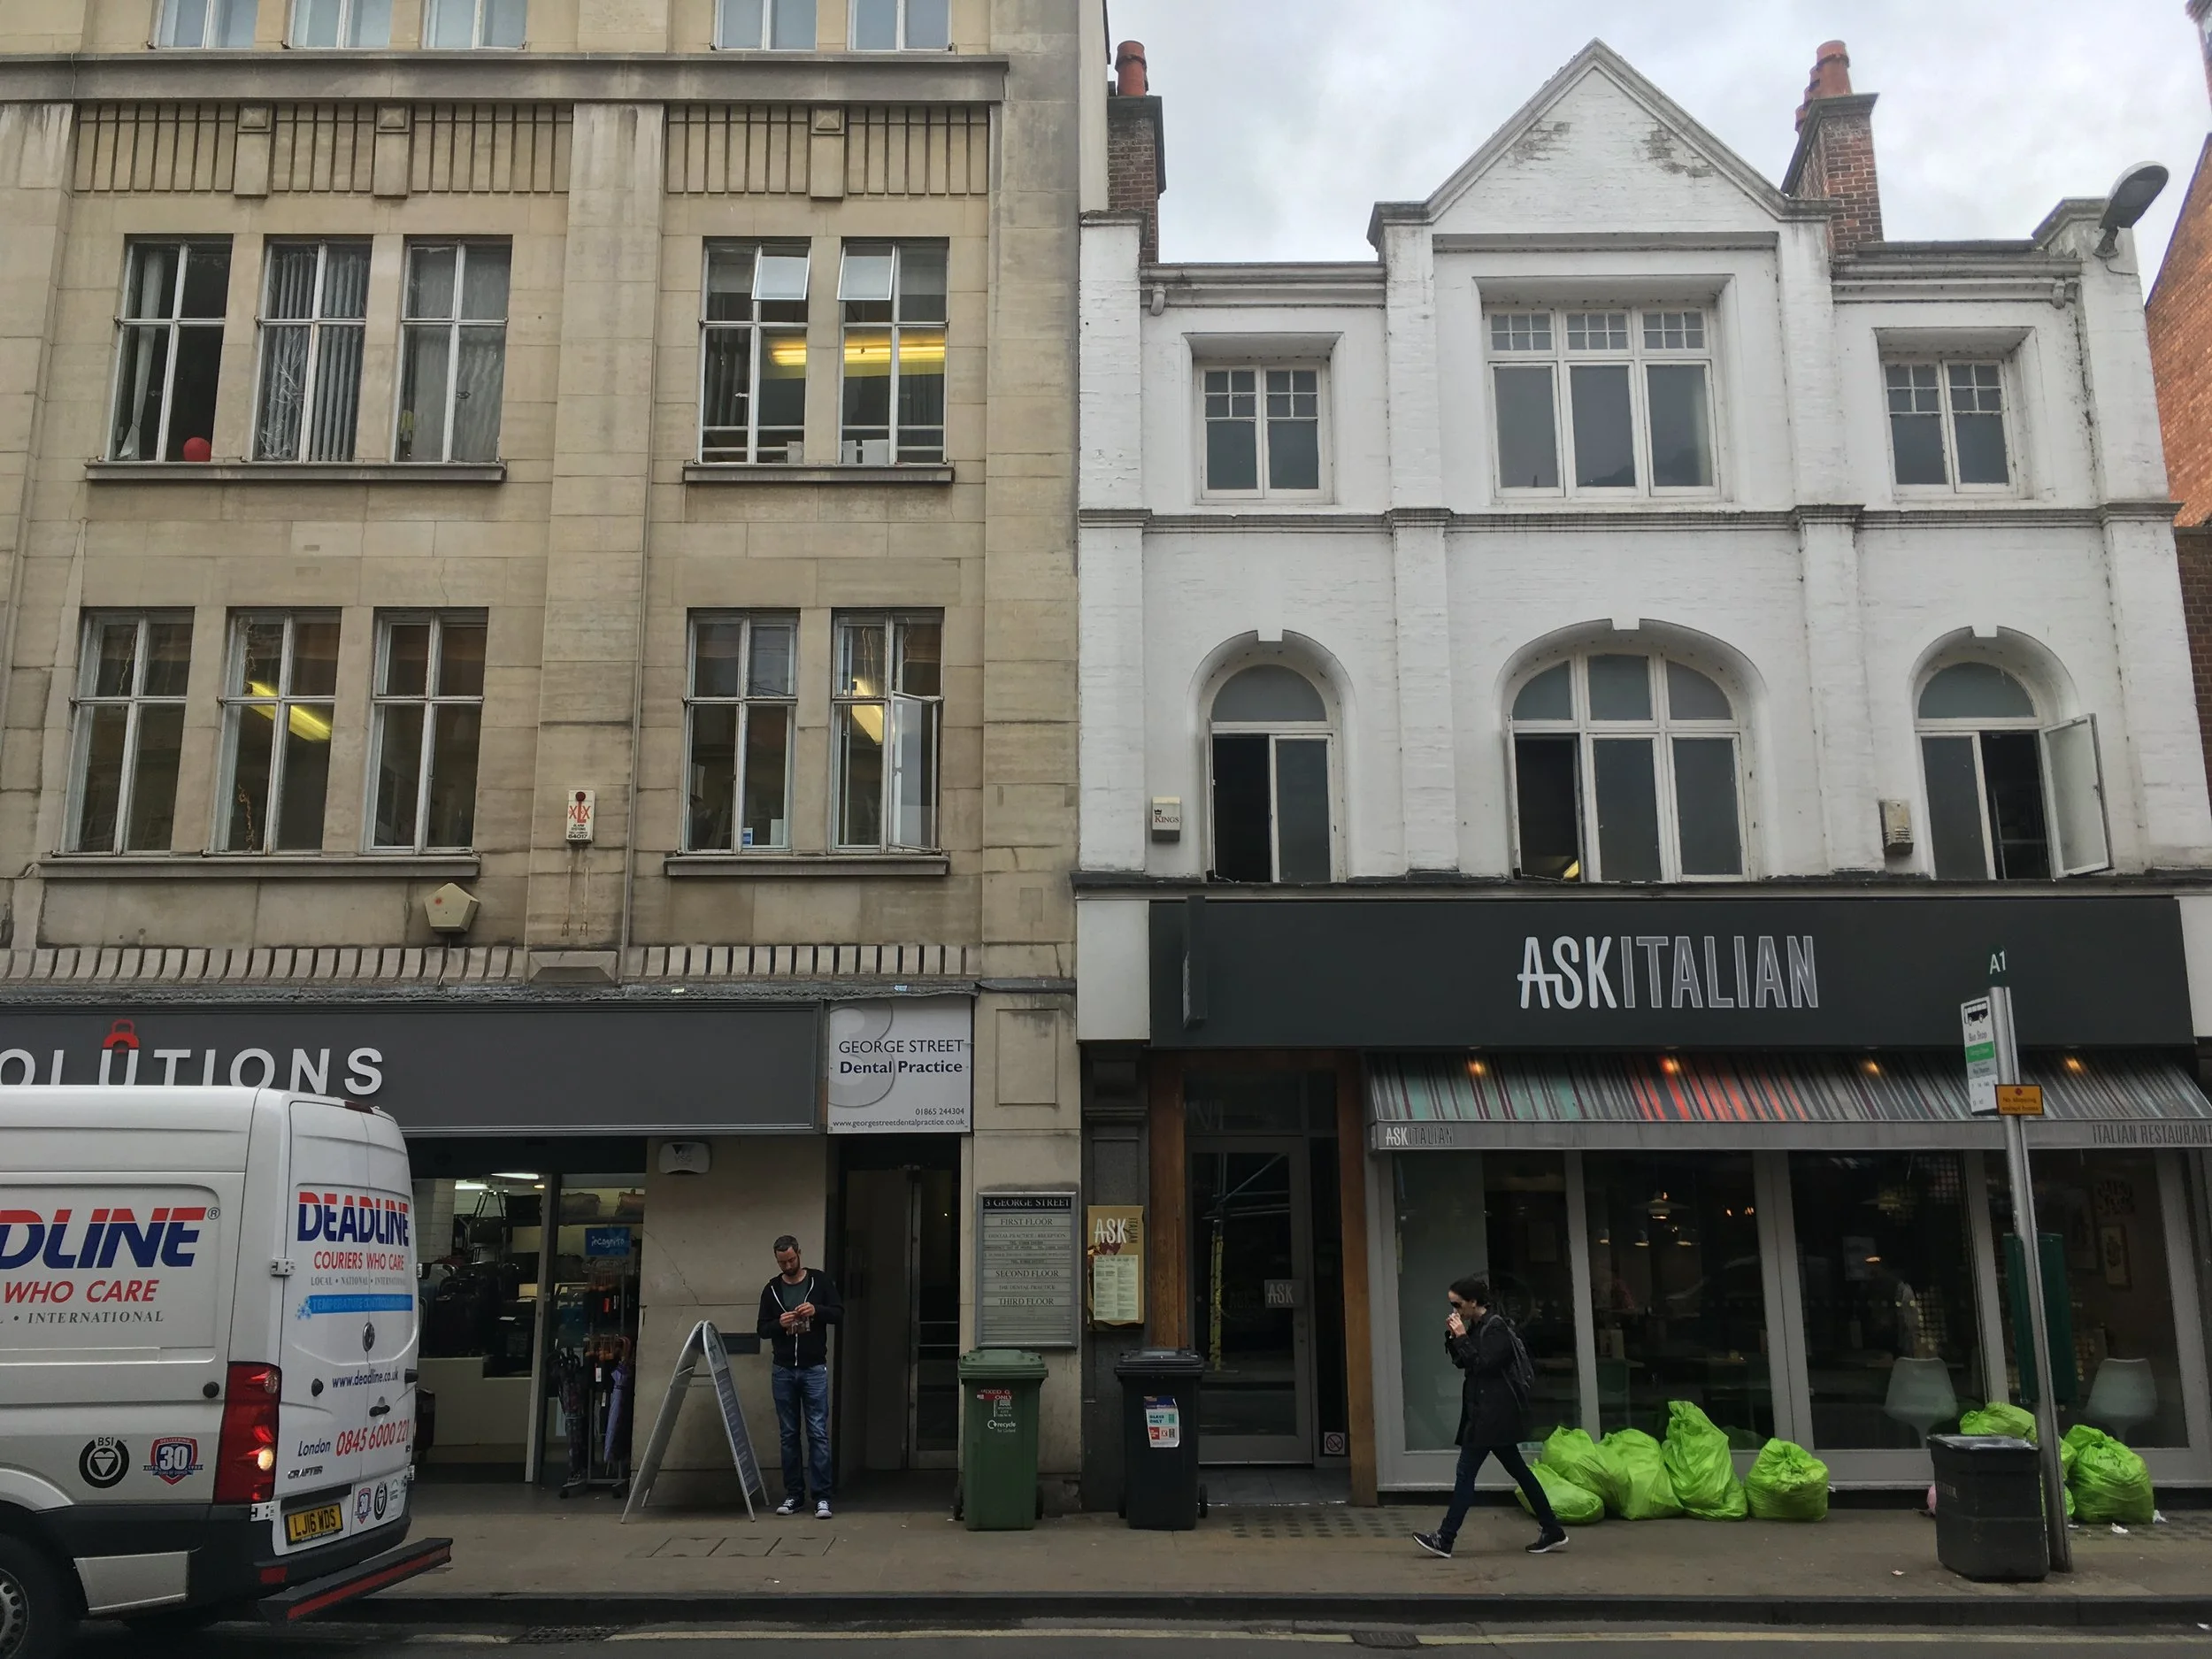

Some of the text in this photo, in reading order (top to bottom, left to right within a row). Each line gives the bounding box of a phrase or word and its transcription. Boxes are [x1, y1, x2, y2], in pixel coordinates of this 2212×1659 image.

[1989, 950, 2007, 974] A1
[1517, 935, 1819, 1010] ASK ITALIAN
[839, 1040, 964, 1053] GEORGE STREET
[840, 1060, 963, 1074] Dental Practice
[833, 1118, 964, 1128] www.georgestreetdentalpractice.co.uk
[1386, 1126, 1454, 1146] ASK ITALIAN
[2093, 1125, 2138, 1144] ITALIAN
[297, 1191, 410, 1247] DEADLINE
[1094, 1217, 1126, 1244] ASK
[313, 1251, 403, 1271] COURIERS WHO CARE
[311, 1277, 333, 1286] LOCAL
[341, 1276, 368, 1285] NATIONAL
[4, 1280, 160, 1303] WHO CARE
[1268, 1283, 1294, 1304] ASK
[28, 1310, 164, 1324] INTERNATIONAL
[333, 1366, 399, 1388] www.deadline.co.uk
[97, 1437, 114, 1447] BSI
[298, 1438, 331, 1456] London
[336, 1427, 368, 1456] 0845
[368, 1422, 396, 1449] 6000
[159, 1446, 188, 1471] 30
[288, 1465, 323, 1479] CRAFTER
[294, 1508, 336, 1537] LJ16 WDS
